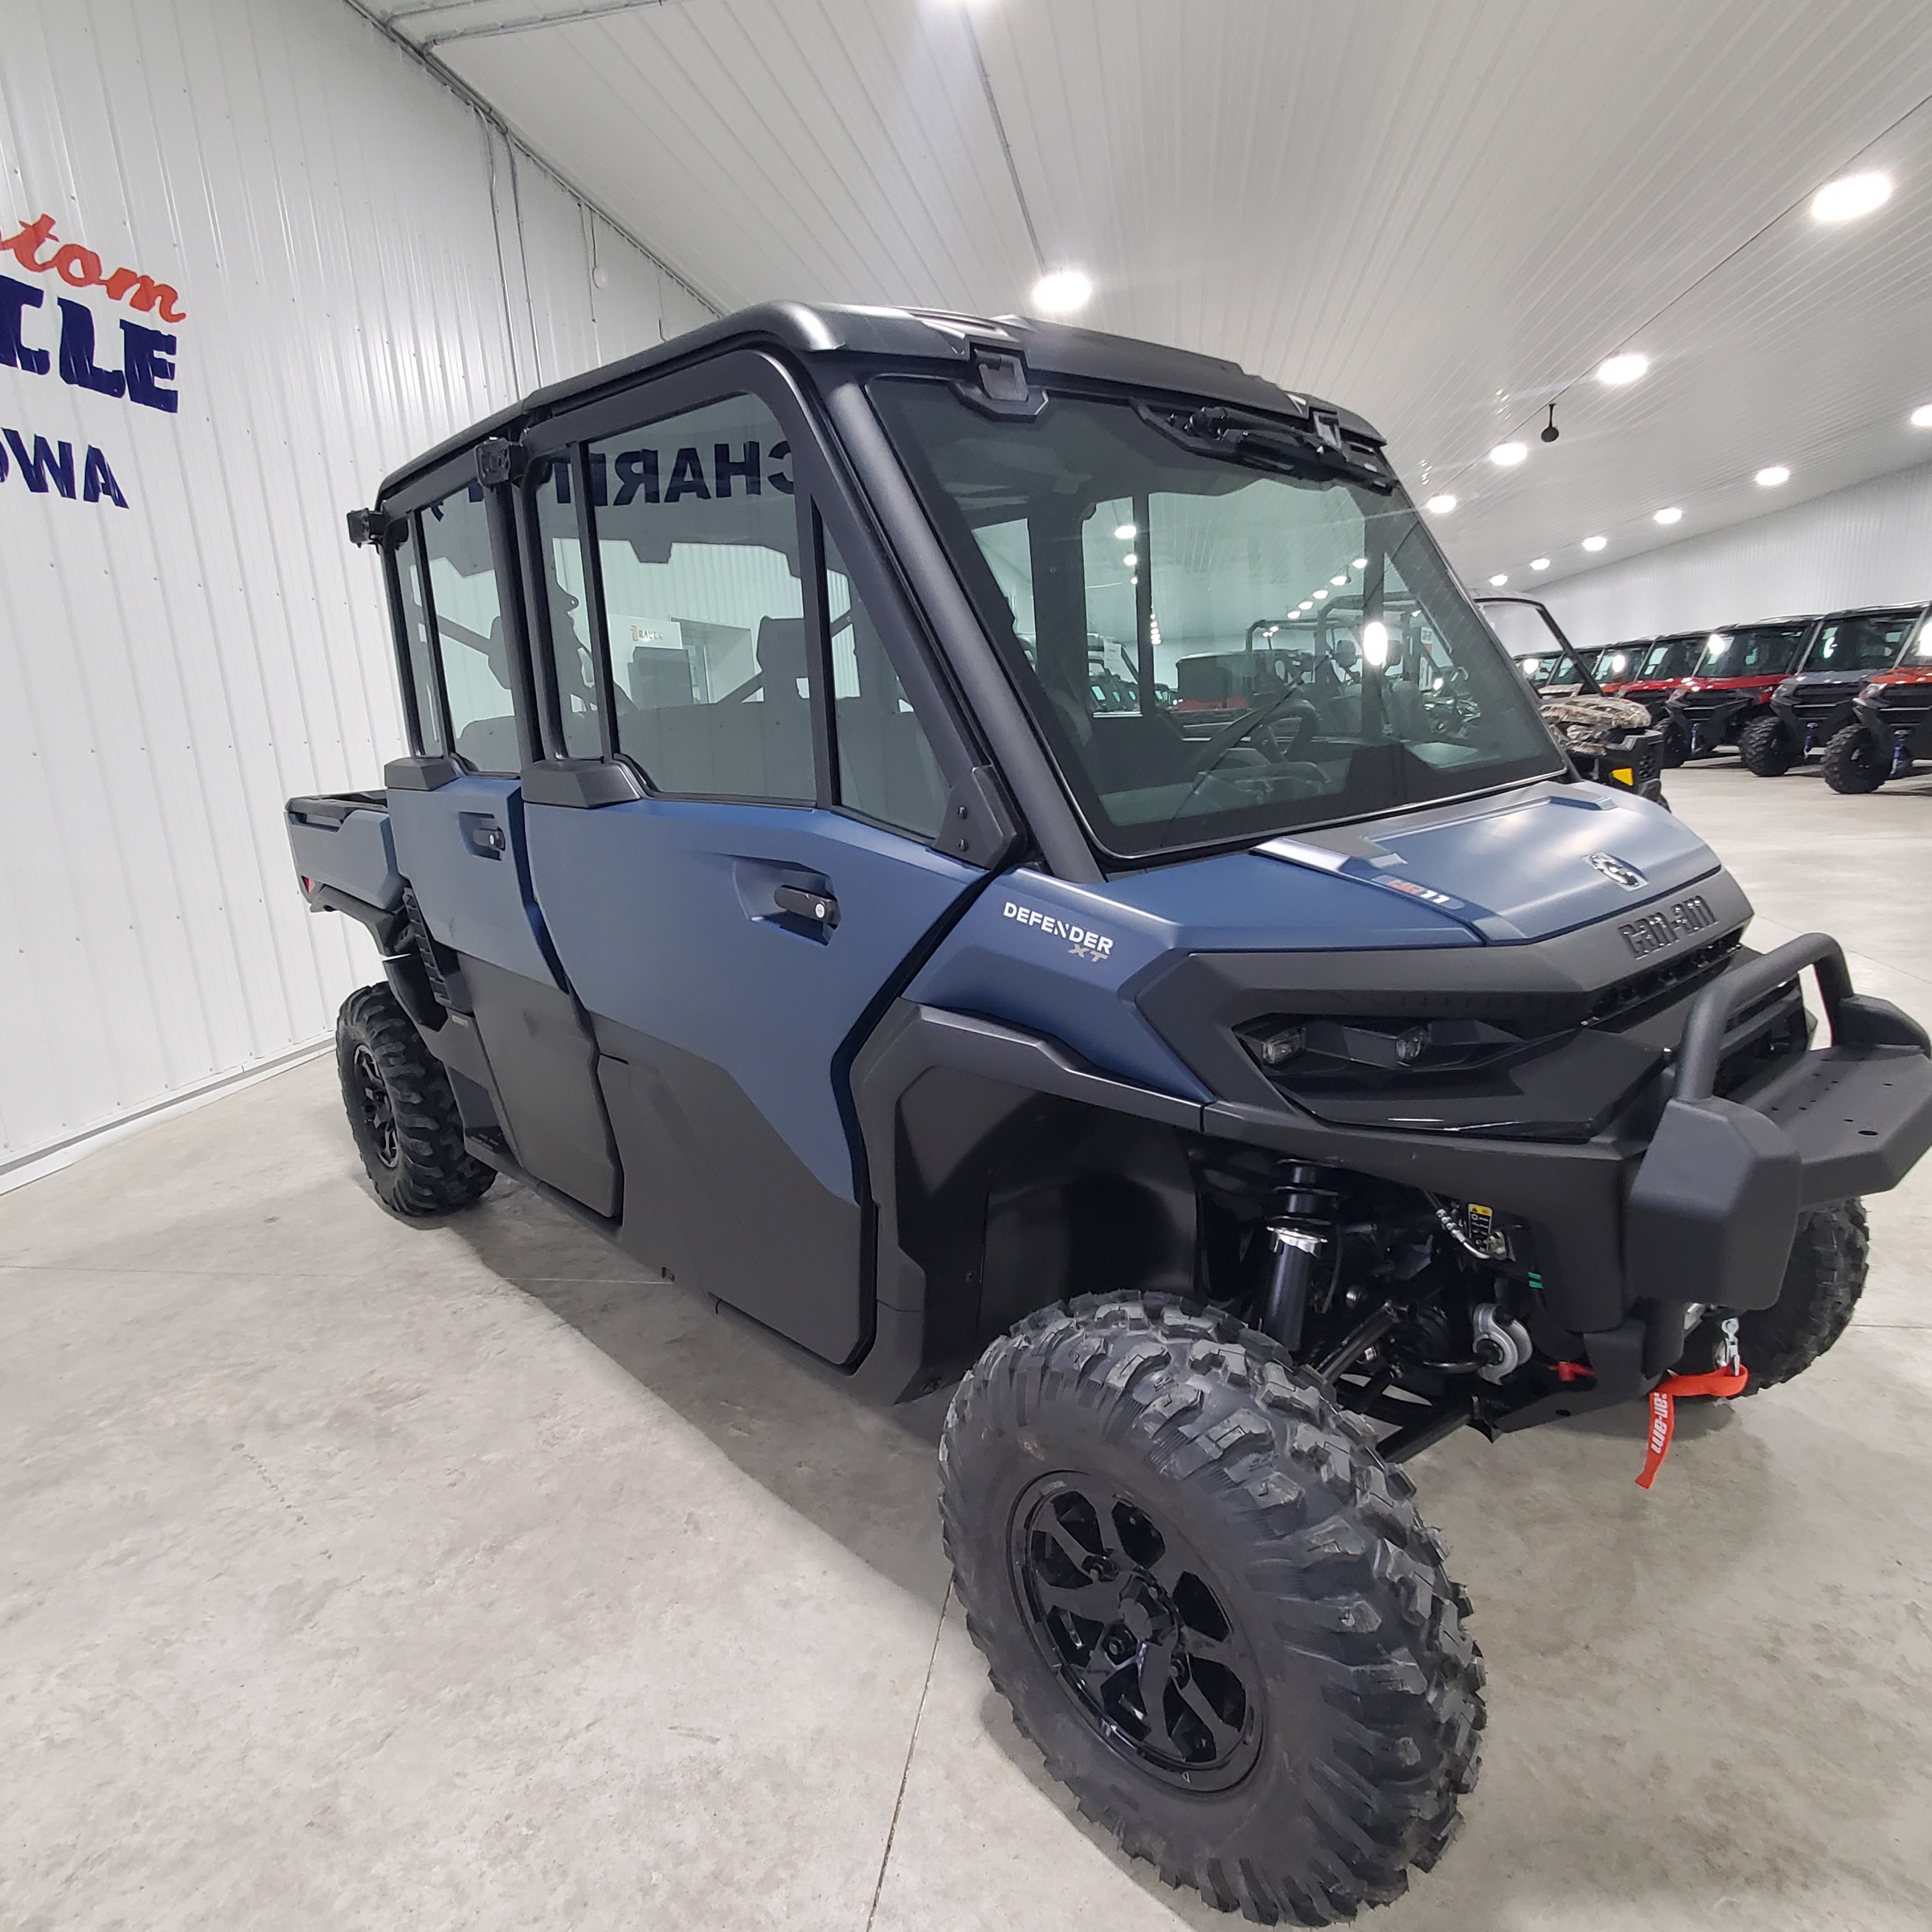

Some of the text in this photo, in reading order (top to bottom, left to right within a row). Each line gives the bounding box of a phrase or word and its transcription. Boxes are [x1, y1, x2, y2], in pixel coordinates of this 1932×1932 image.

[0, 213, 187, 323] tom
[0, 426, 130, 510] WA
[1003, 901, 1114, 954] DEFENDER
[1067, 943, 1109, 963] XT
